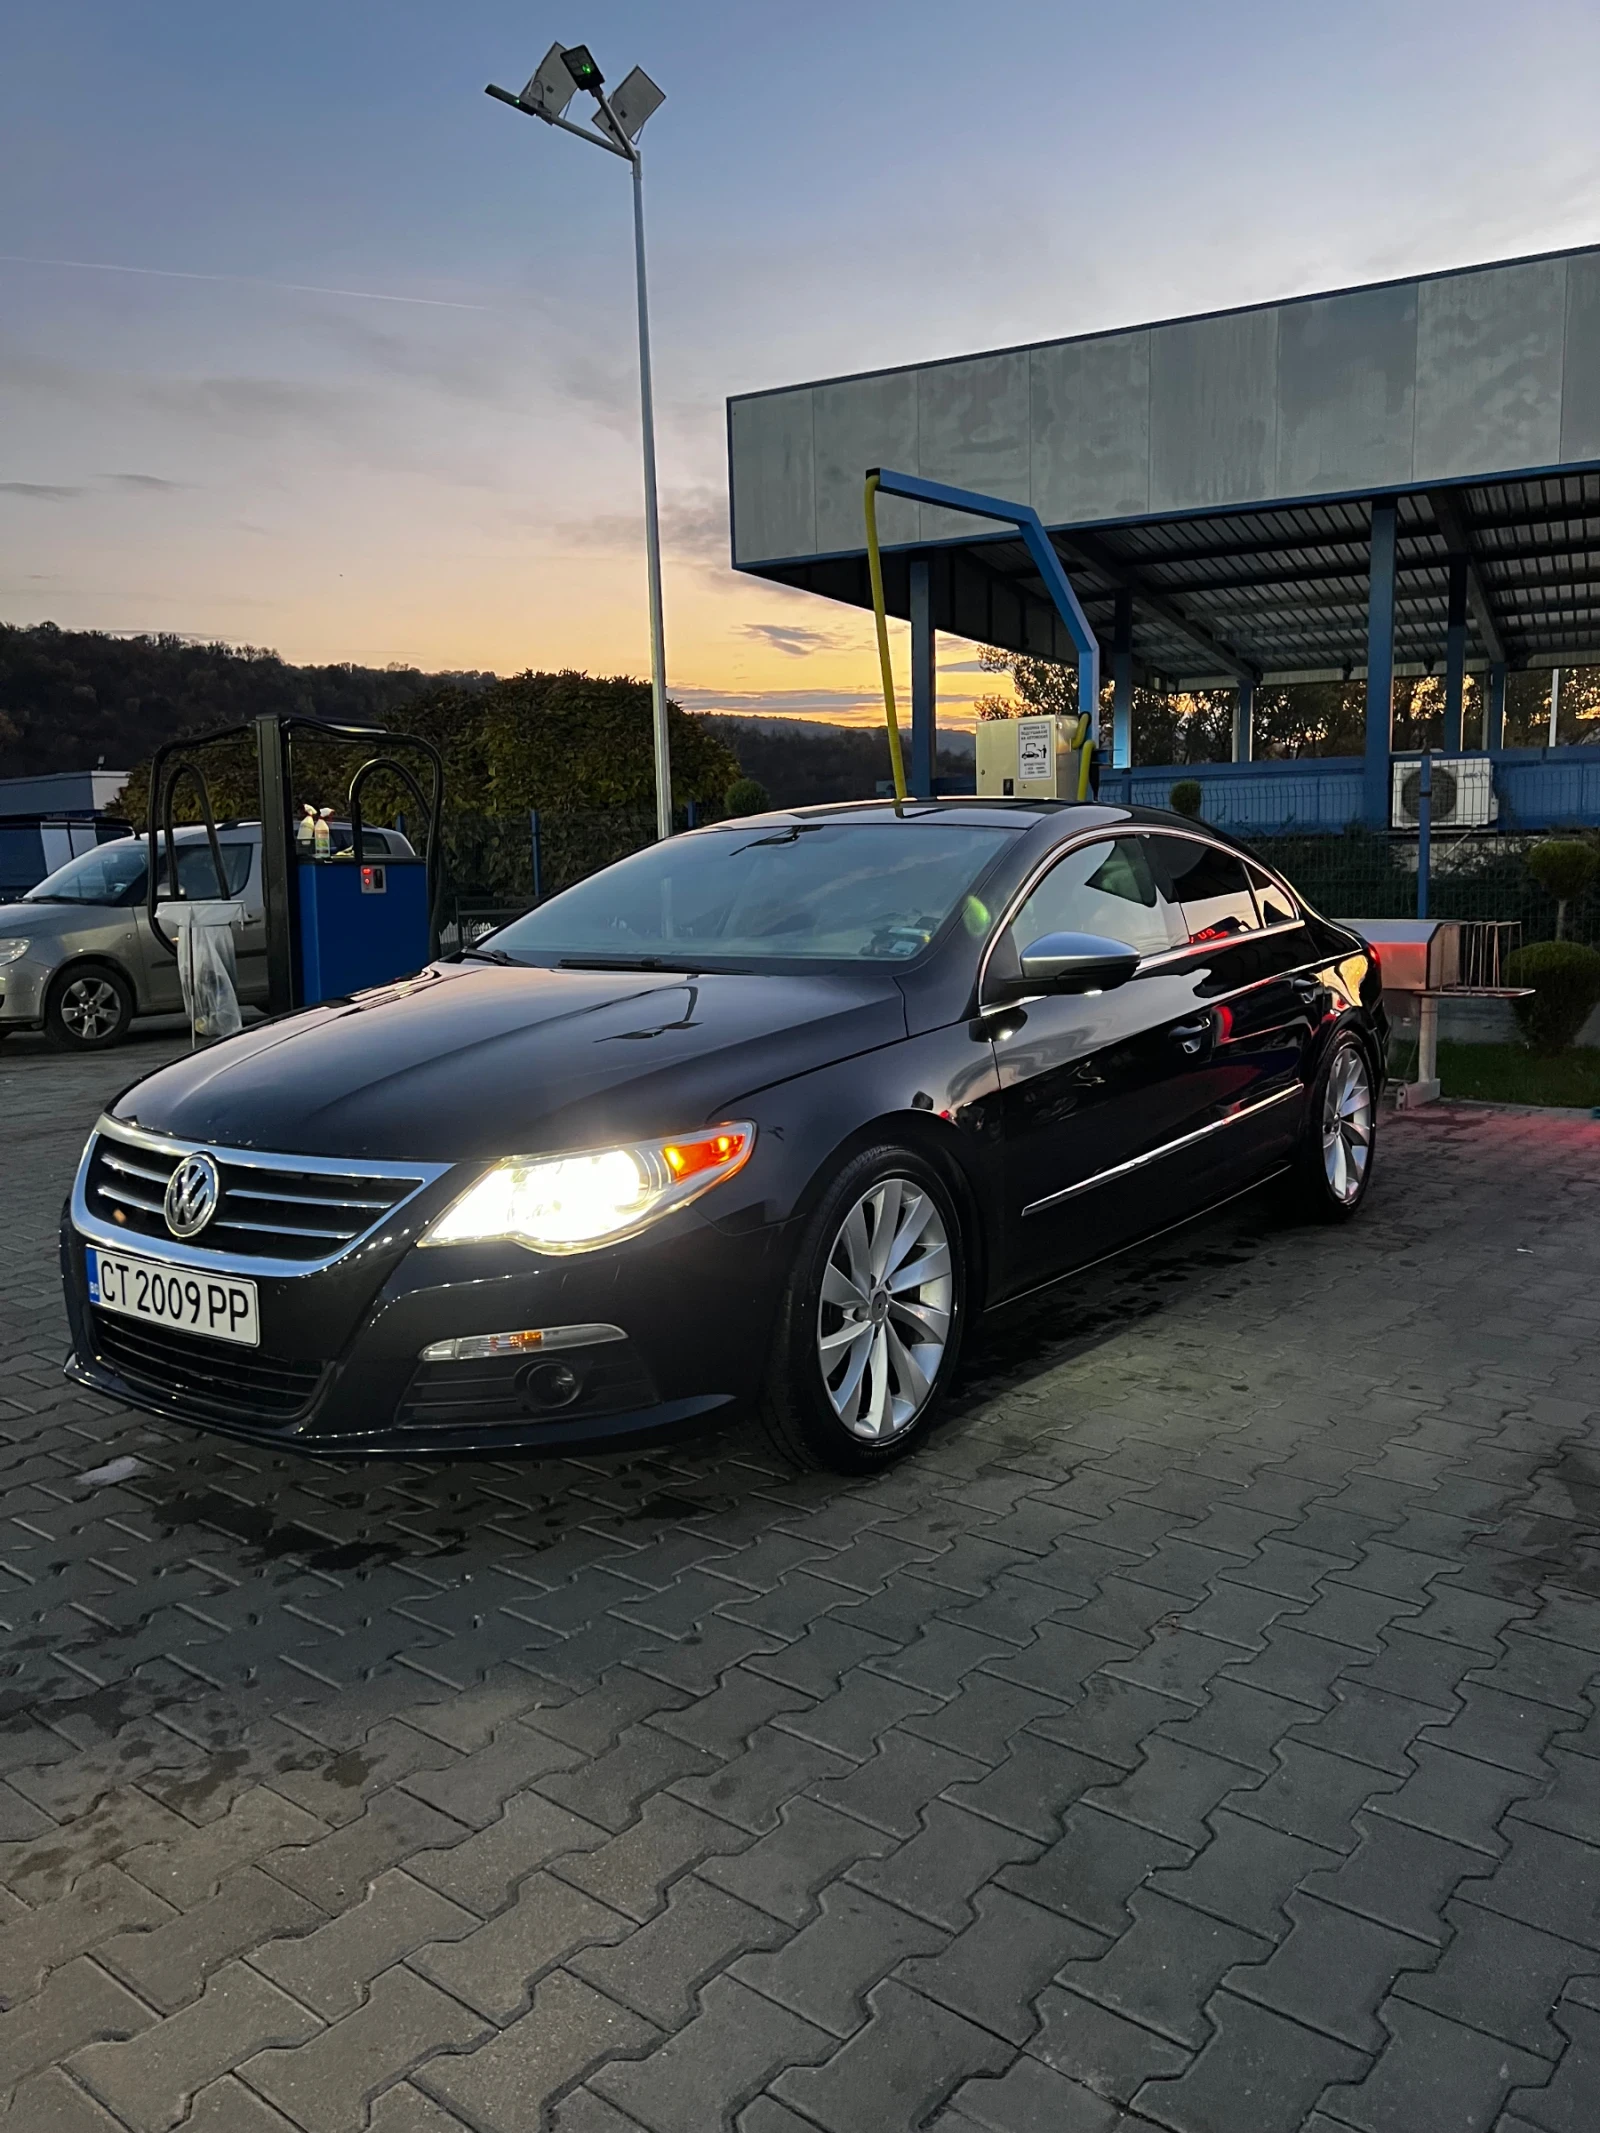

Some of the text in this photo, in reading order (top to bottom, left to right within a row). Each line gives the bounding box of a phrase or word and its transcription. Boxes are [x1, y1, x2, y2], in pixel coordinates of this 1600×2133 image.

[101, 1260, 249, 1333] CT 2009 PP
